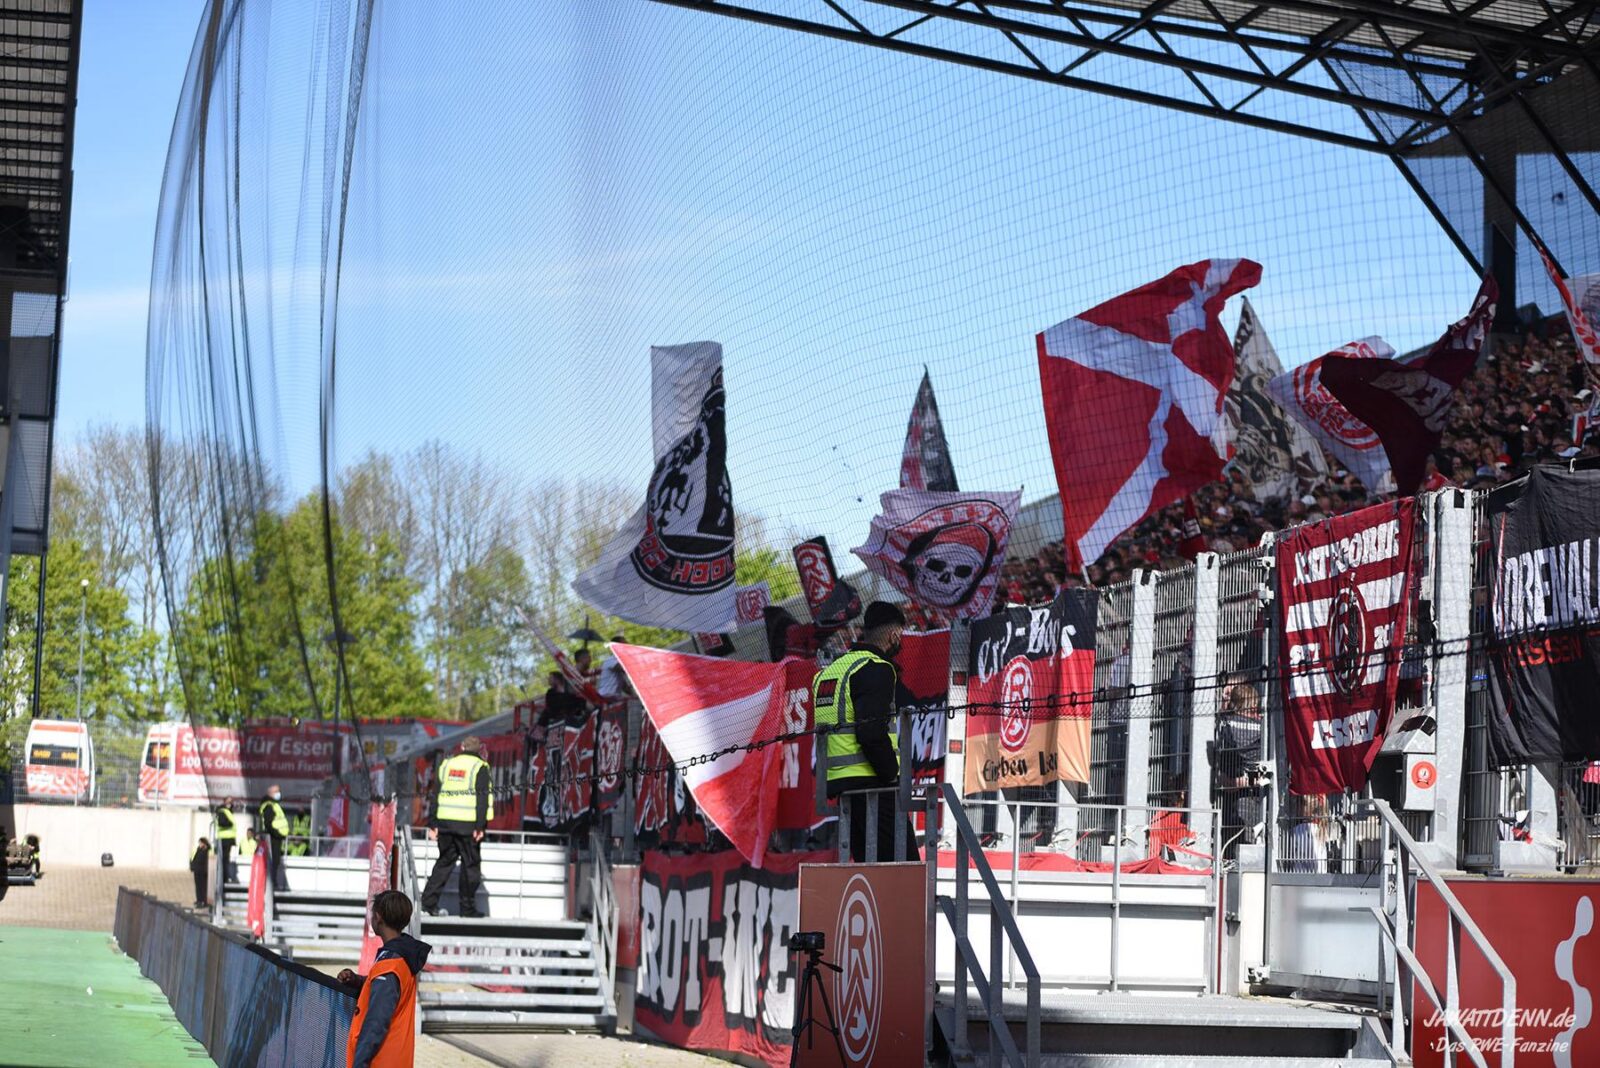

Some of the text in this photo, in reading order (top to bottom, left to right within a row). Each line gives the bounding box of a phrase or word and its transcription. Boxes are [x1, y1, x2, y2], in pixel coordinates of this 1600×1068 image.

[181, 732, 334, 757] Strom für Essen
